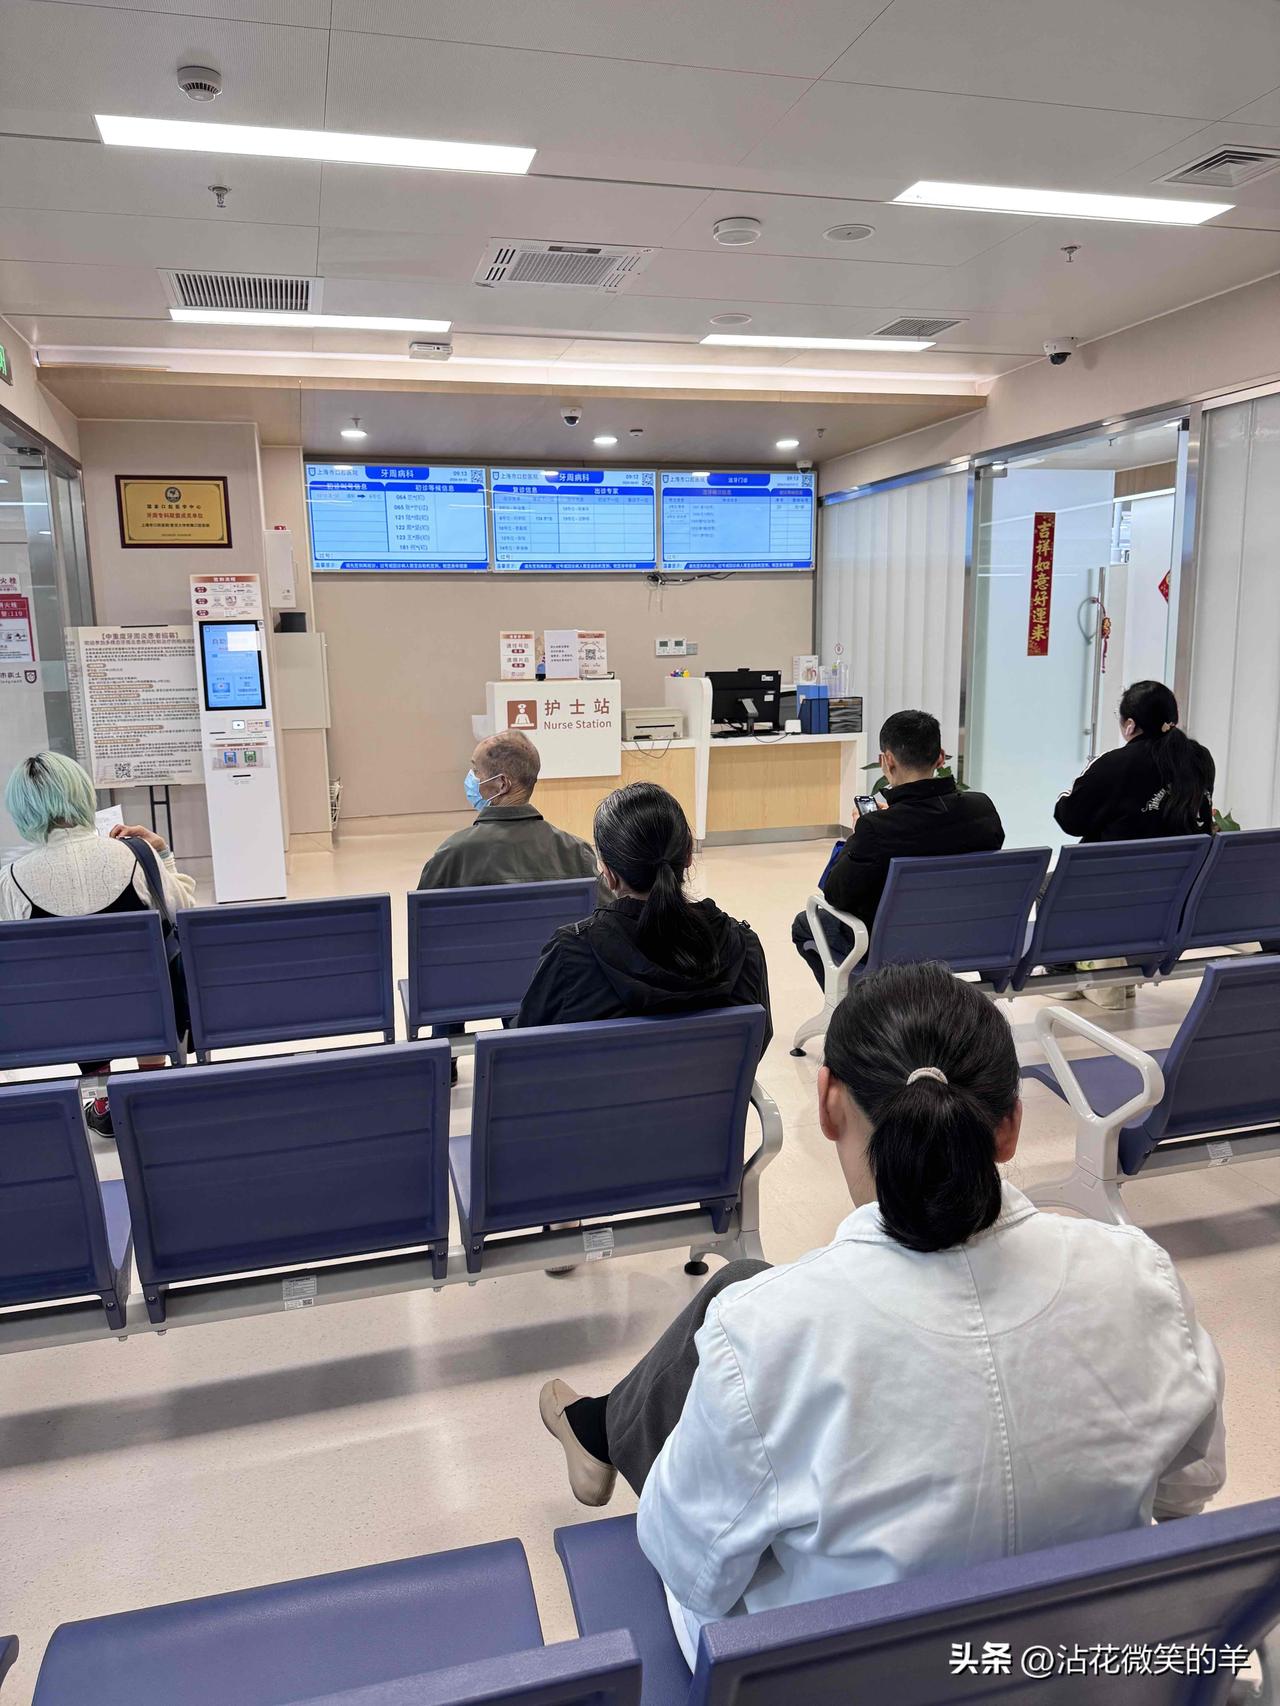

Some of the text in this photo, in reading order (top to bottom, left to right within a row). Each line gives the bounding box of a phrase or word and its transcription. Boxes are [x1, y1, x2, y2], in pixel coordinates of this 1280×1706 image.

[380, 469, 414, 478] 牙周病科
[559, 473, 590, 482] 牙周病科
[512, 486, 538, 494] 复诊信息
[594, 487, 619, 495] 出诊专家
[544, 698, 610, 717] 护士站
[544, 720, 612, 730] Nurse Station
